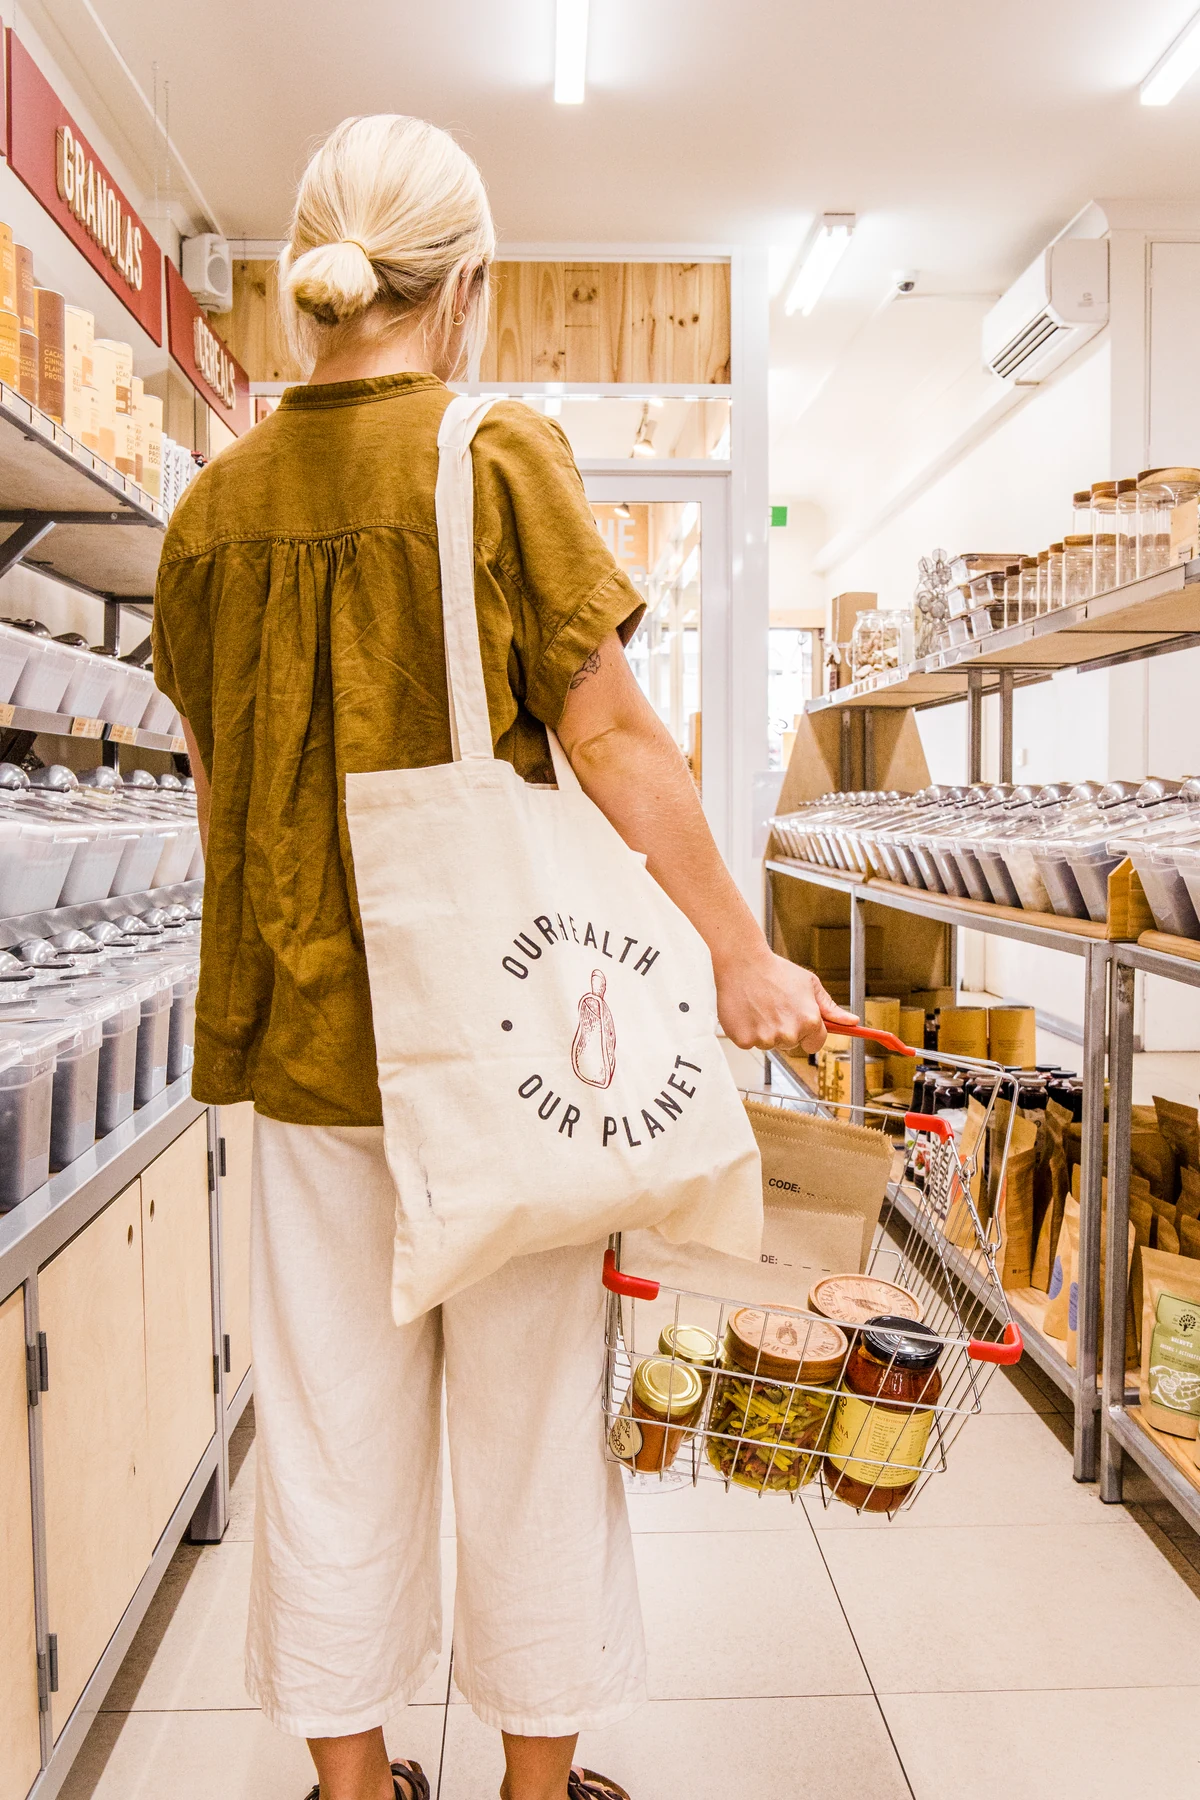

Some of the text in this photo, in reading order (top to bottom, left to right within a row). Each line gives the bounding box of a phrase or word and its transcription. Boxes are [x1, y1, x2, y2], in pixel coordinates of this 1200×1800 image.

[60, 125, 143, 292] GRANOLAS
[196, 316, 236, 410] CEREALS
[598, 518, 636, 558] HE
[502, 911, 661, 980] OUR HEALTH
[518, 1055, 702, 1148] OUR PLANET
[768, 1177, 801, 1194] CODE:
[760, 1253, 779, 1265] DE:
[762, 1341, 788, 1355] OUR
